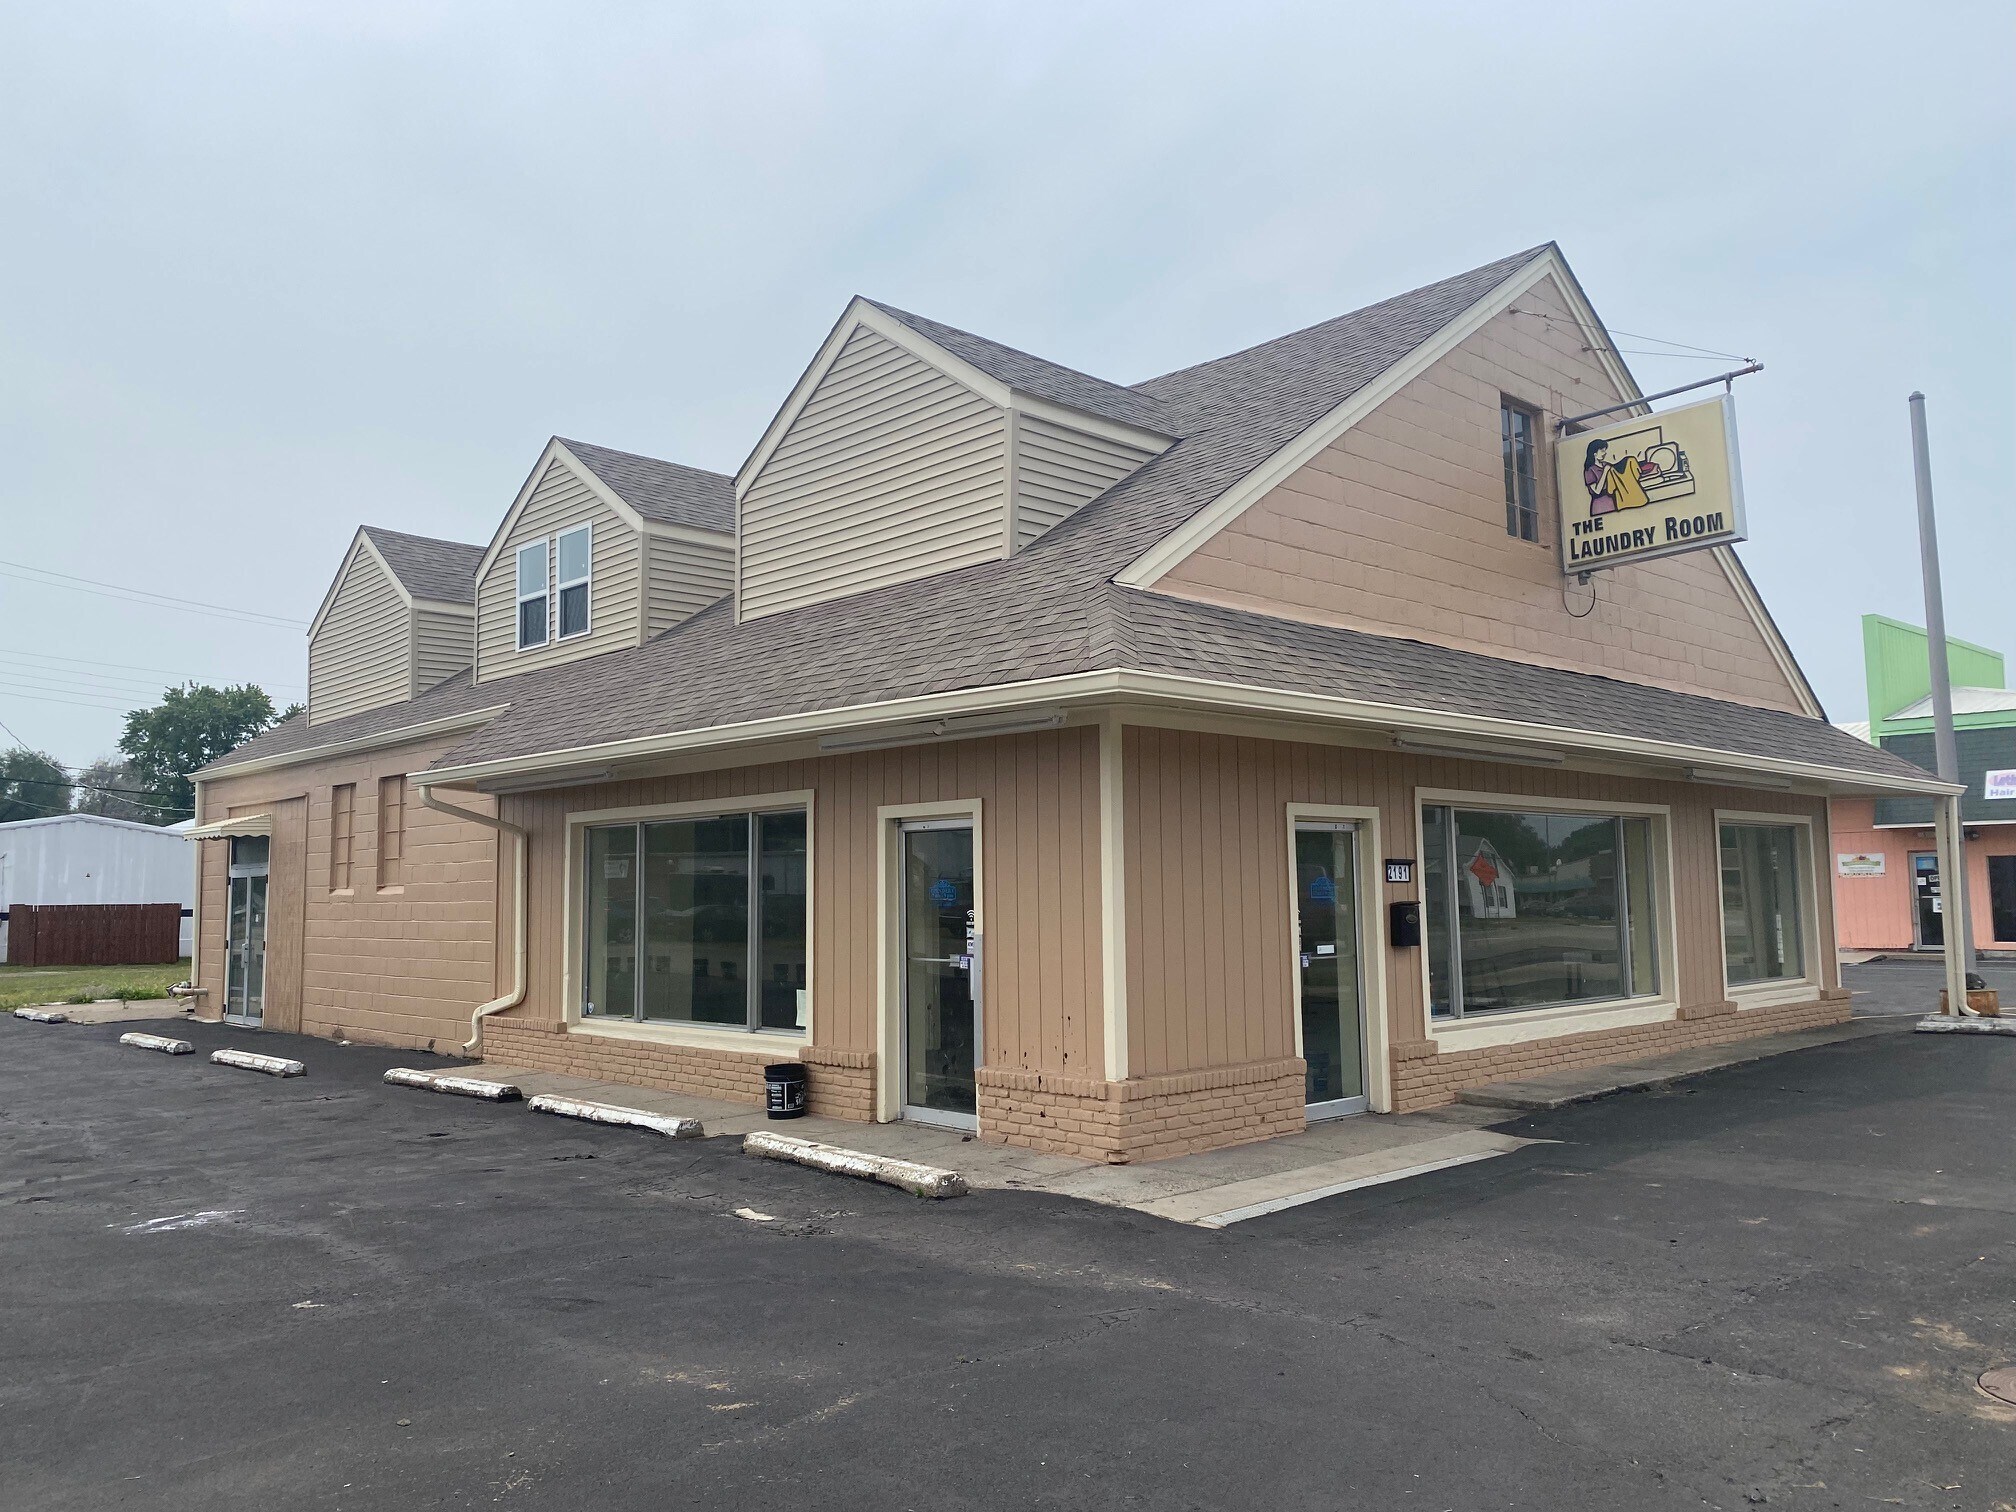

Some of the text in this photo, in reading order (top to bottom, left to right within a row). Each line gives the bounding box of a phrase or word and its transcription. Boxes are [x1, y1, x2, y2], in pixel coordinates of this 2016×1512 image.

[1570, 512, 1724, 560] LAUNDRY ROOM
[1572, 517, 1604, 536] THE
[1990, 789, 2015, 797] Hair
